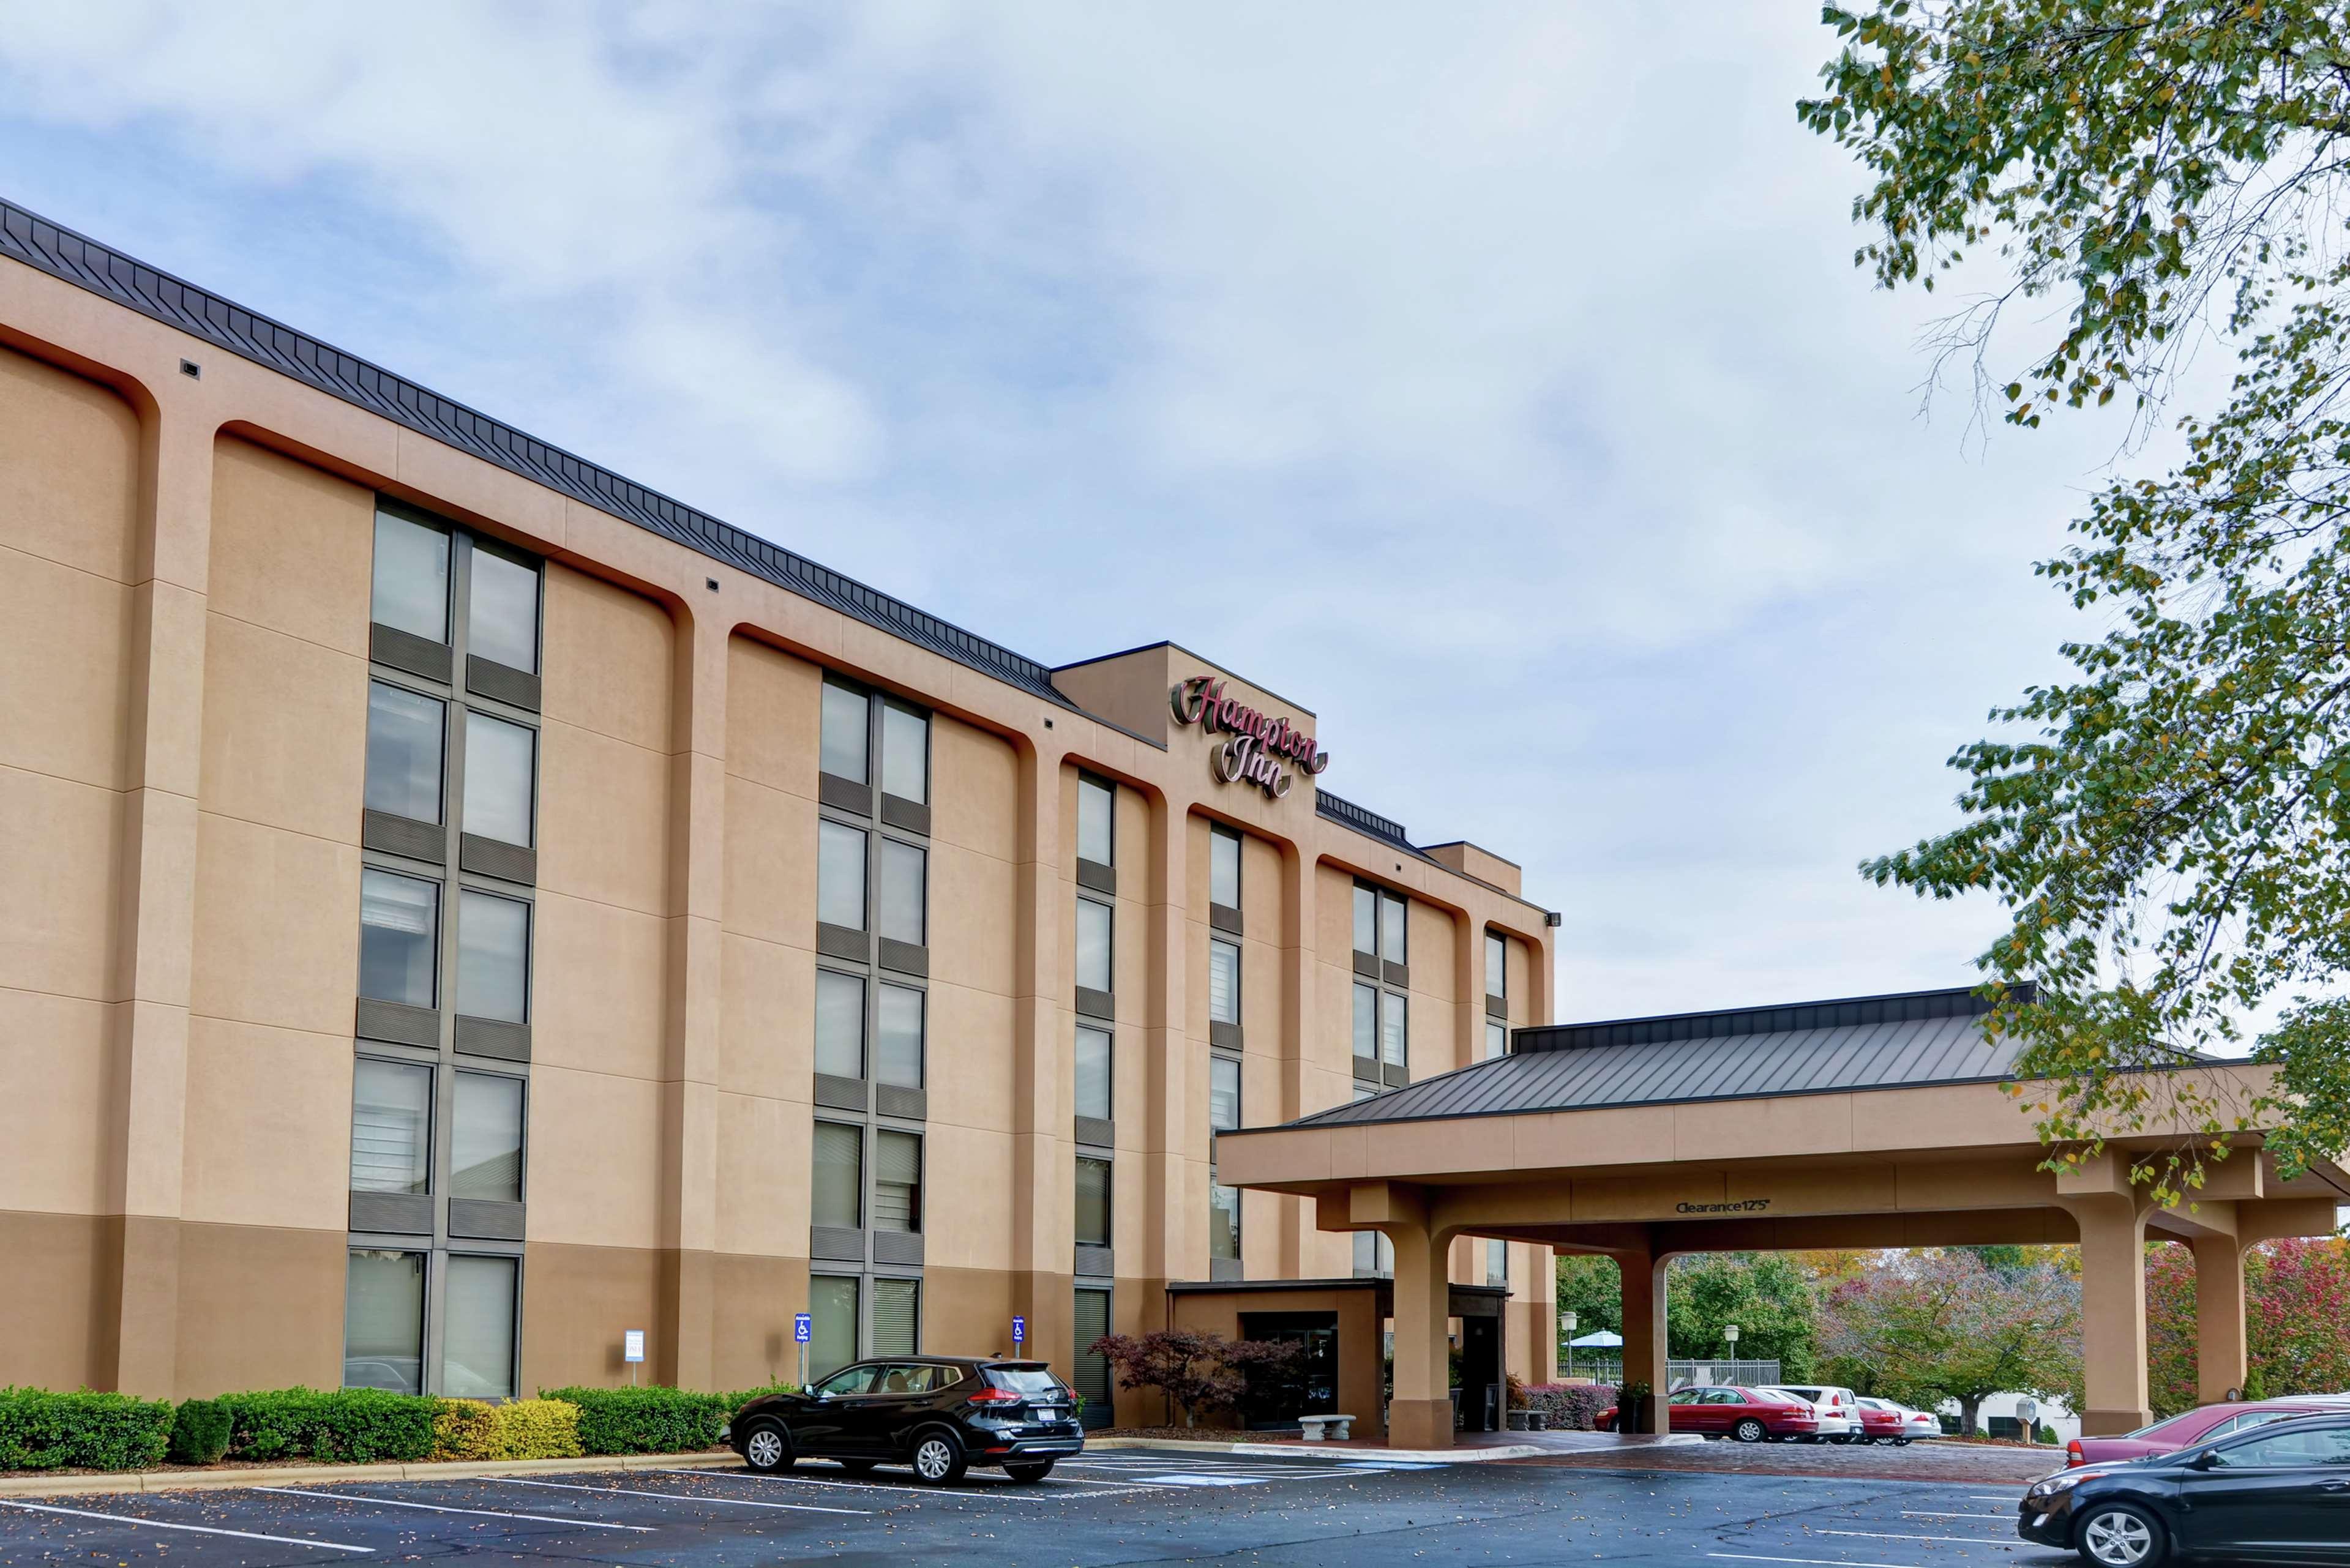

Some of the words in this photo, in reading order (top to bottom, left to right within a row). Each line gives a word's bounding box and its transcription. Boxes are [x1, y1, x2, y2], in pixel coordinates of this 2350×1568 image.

[1172, 676, 1328, 775] Hampton
[1211, 734, 1293, 799] Inn
[1676, 1202, 1741, 1213] Clearance
